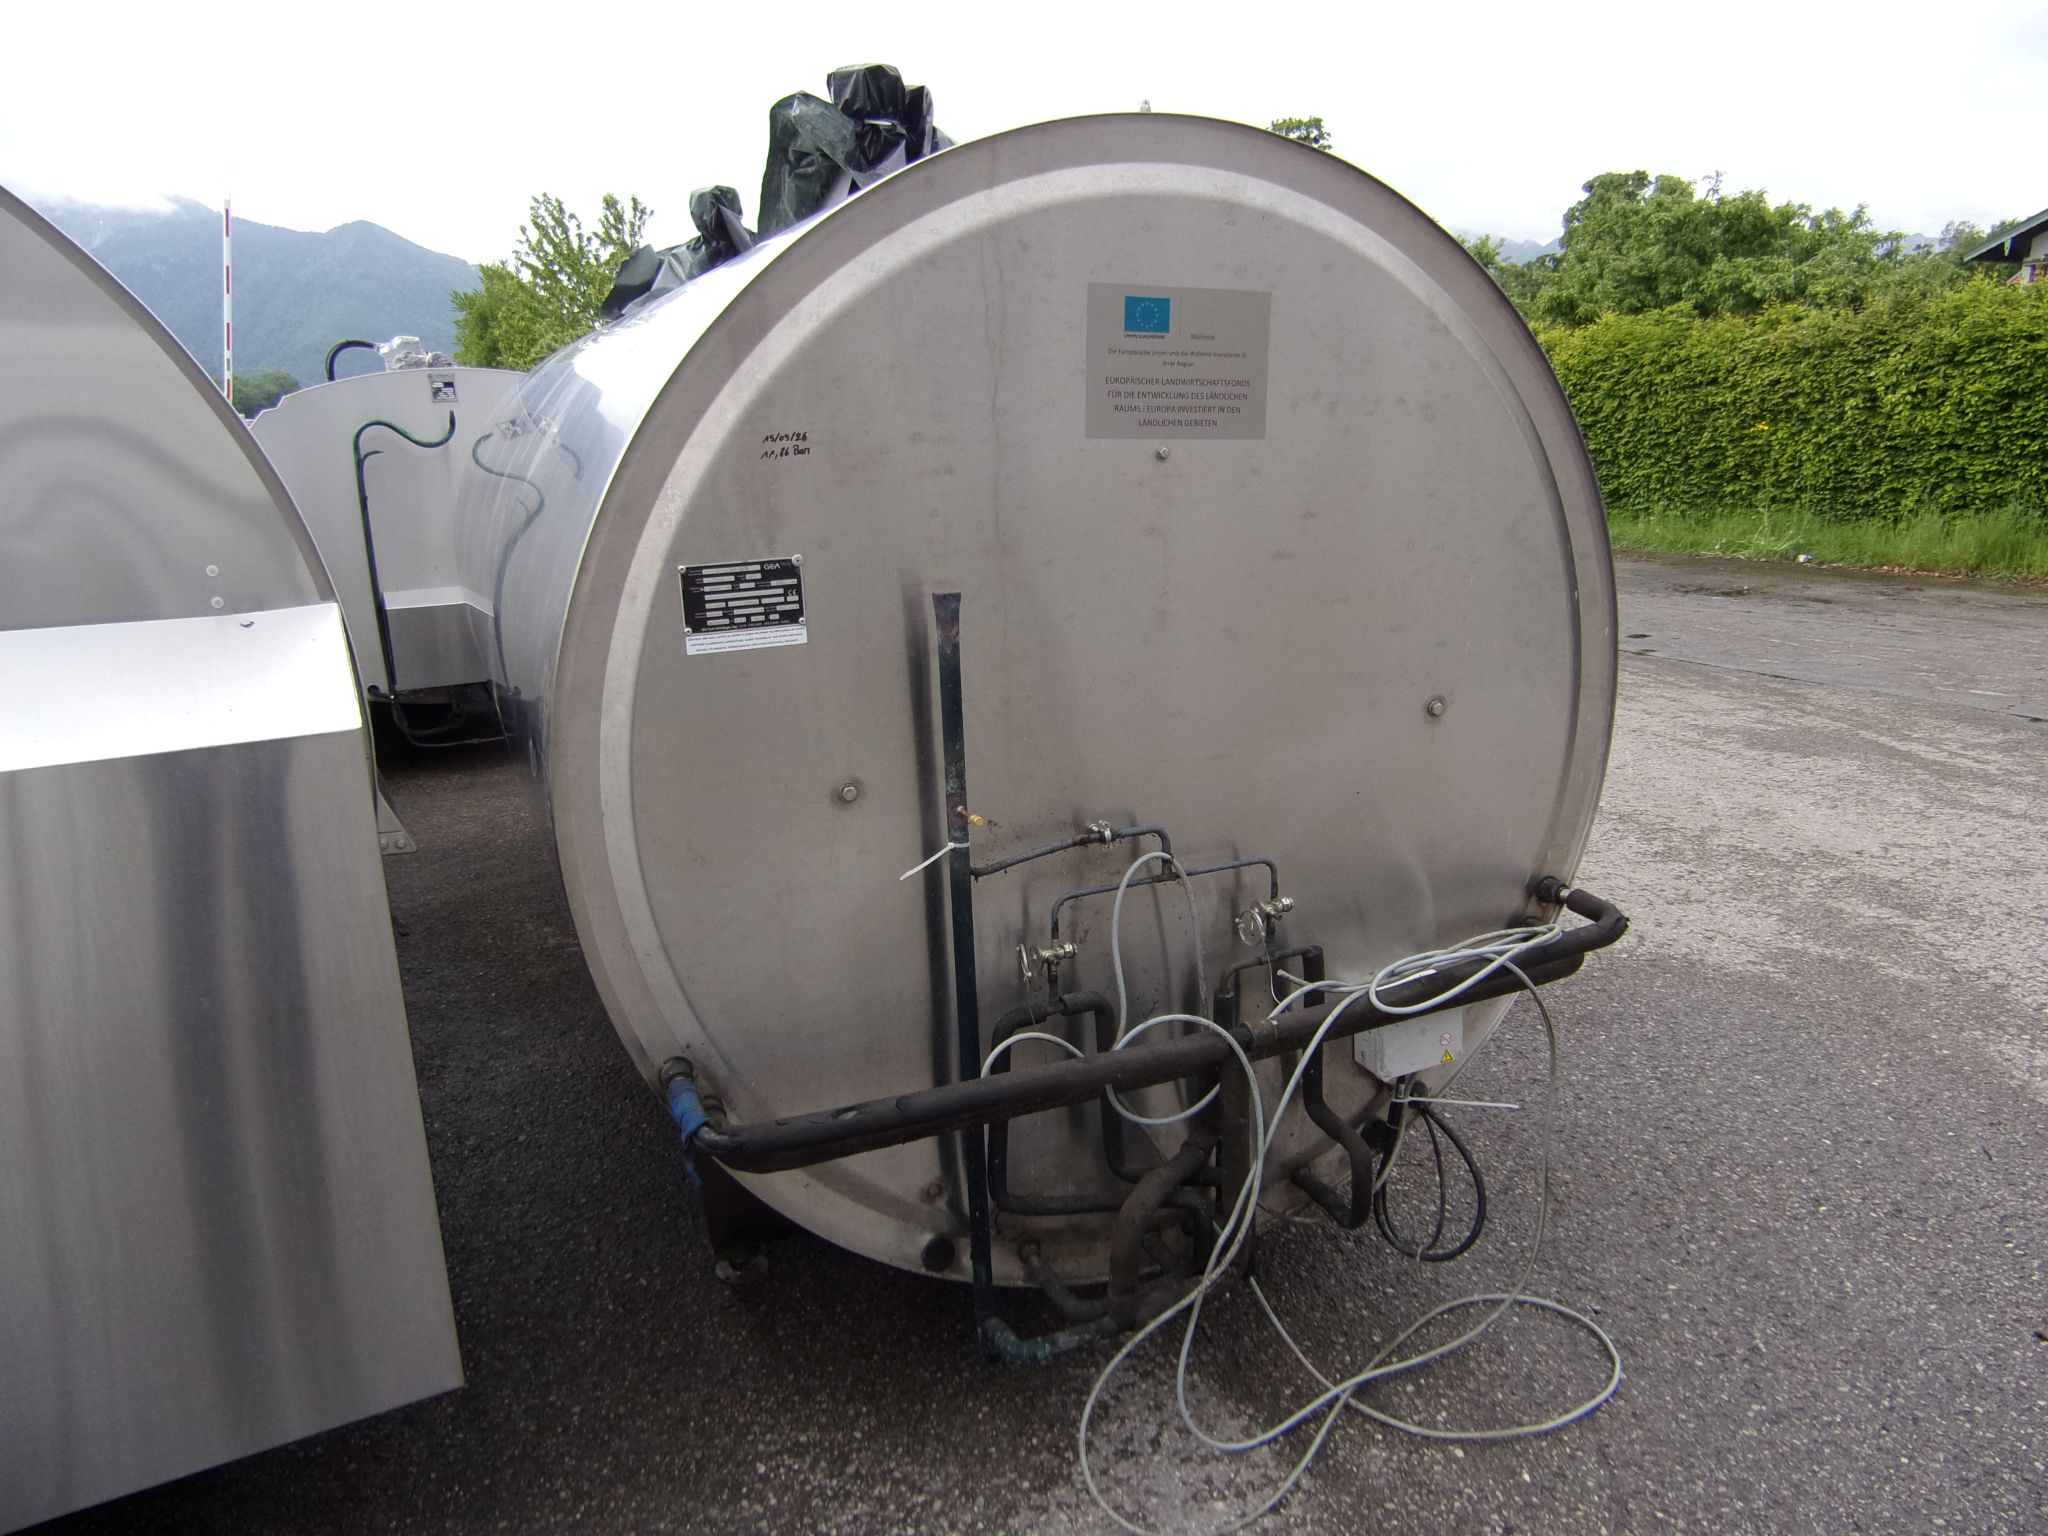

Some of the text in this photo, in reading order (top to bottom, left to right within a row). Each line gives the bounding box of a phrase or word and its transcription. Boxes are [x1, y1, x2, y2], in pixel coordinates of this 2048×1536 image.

[1105, 376, 1250, 387] EUROPÄISCHER LANDWIRTSCHAFTSFONDS
[1107, 390, 1122, 399] FÜR
[1124, 391, 1135, 399] DIE
[1138, 392, 1189, 400] ENTWICKLUNG
[1206, 391, 1248, 401] LÄNDLICHEN
[1178, 406, 1216, 414] INVESTIERT
[1138, 417, 1217, 427] LÄNDLICHEN GEBIETEN
